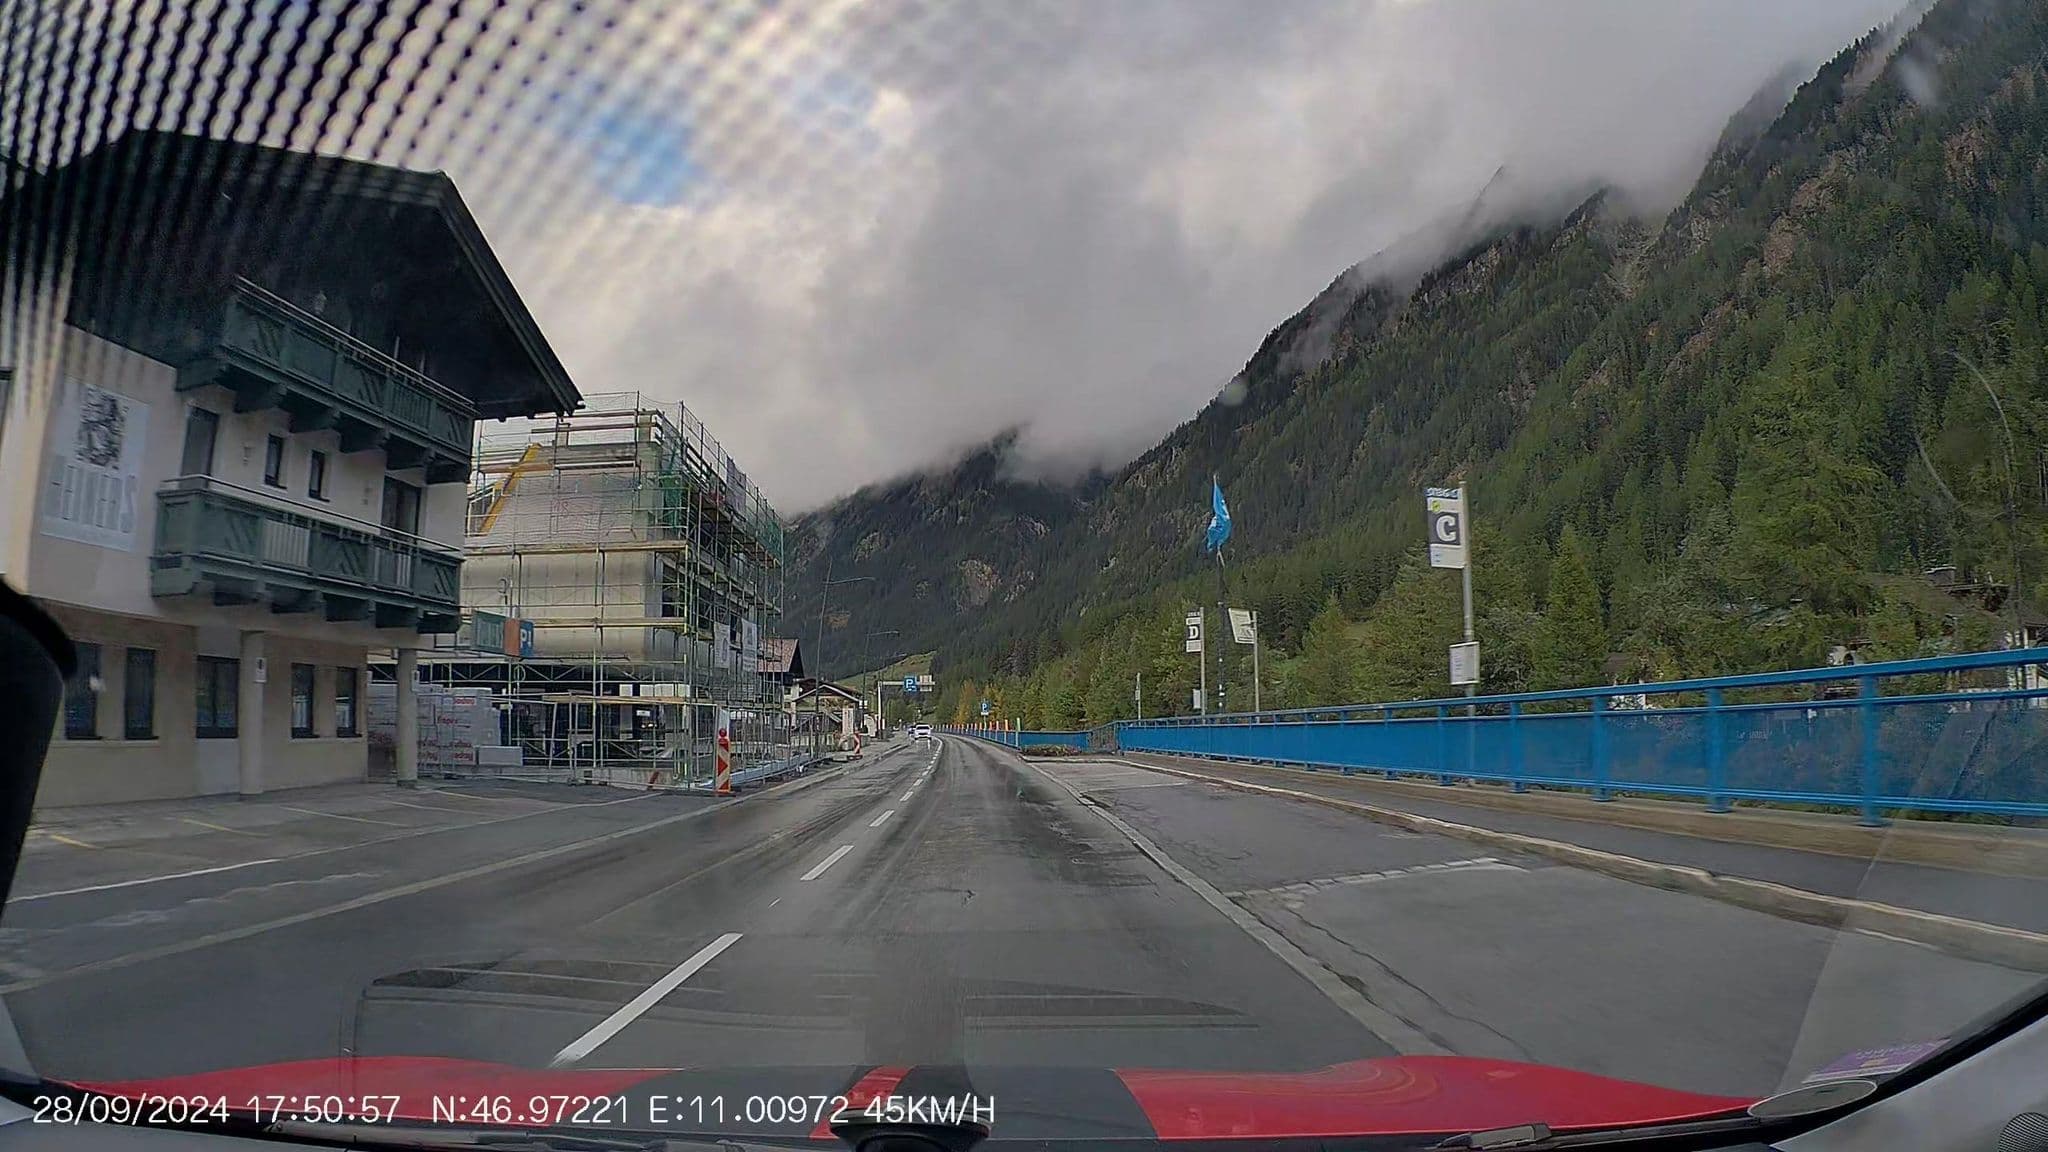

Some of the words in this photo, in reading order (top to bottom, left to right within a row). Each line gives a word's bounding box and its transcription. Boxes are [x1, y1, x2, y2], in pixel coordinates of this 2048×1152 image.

[1436, 515, 1457, 542] C
[1188, 626, 1199, 639] D
[906, 678, 914, 689] P
